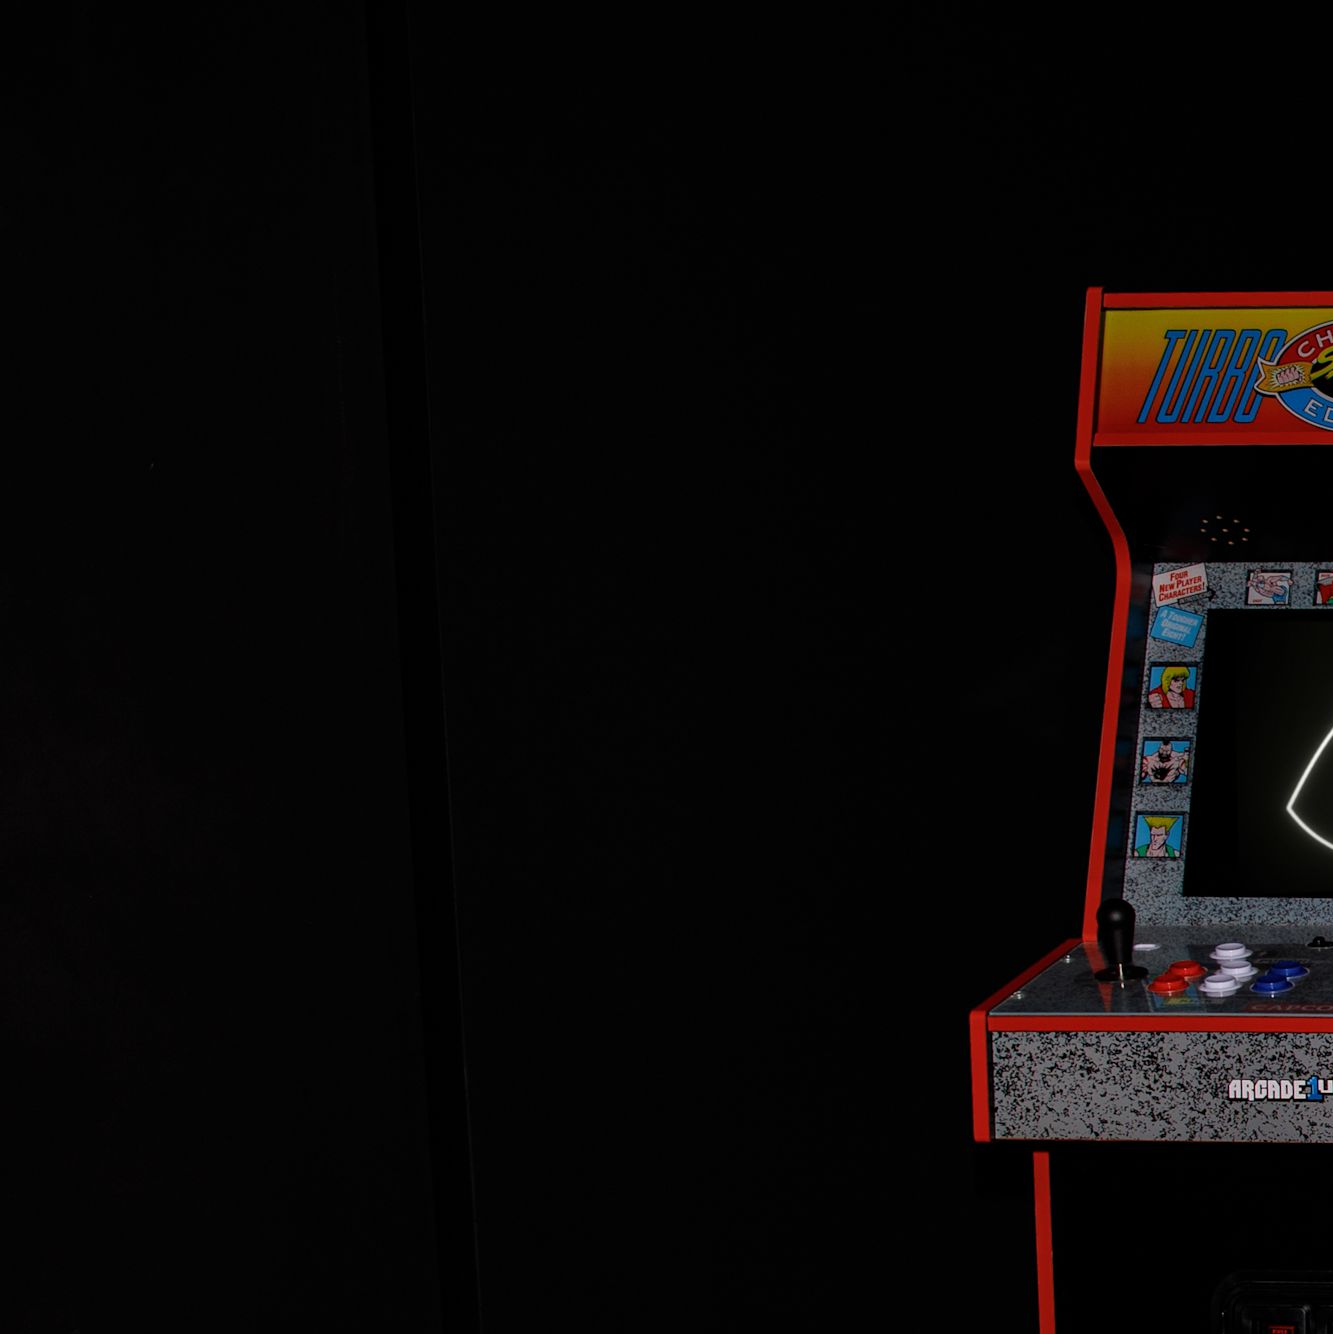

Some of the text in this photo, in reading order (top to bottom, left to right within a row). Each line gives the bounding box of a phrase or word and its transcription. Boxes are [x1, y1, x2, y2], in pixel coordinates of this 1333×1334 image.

[1136, 328, 1288, 424] TURBO
[1159, 576, 1202, 593] NEW PLAYER
[1170, 571, 1189, 582] FOUR
[1158, 582, 1205, 602] CHARACTERS!
